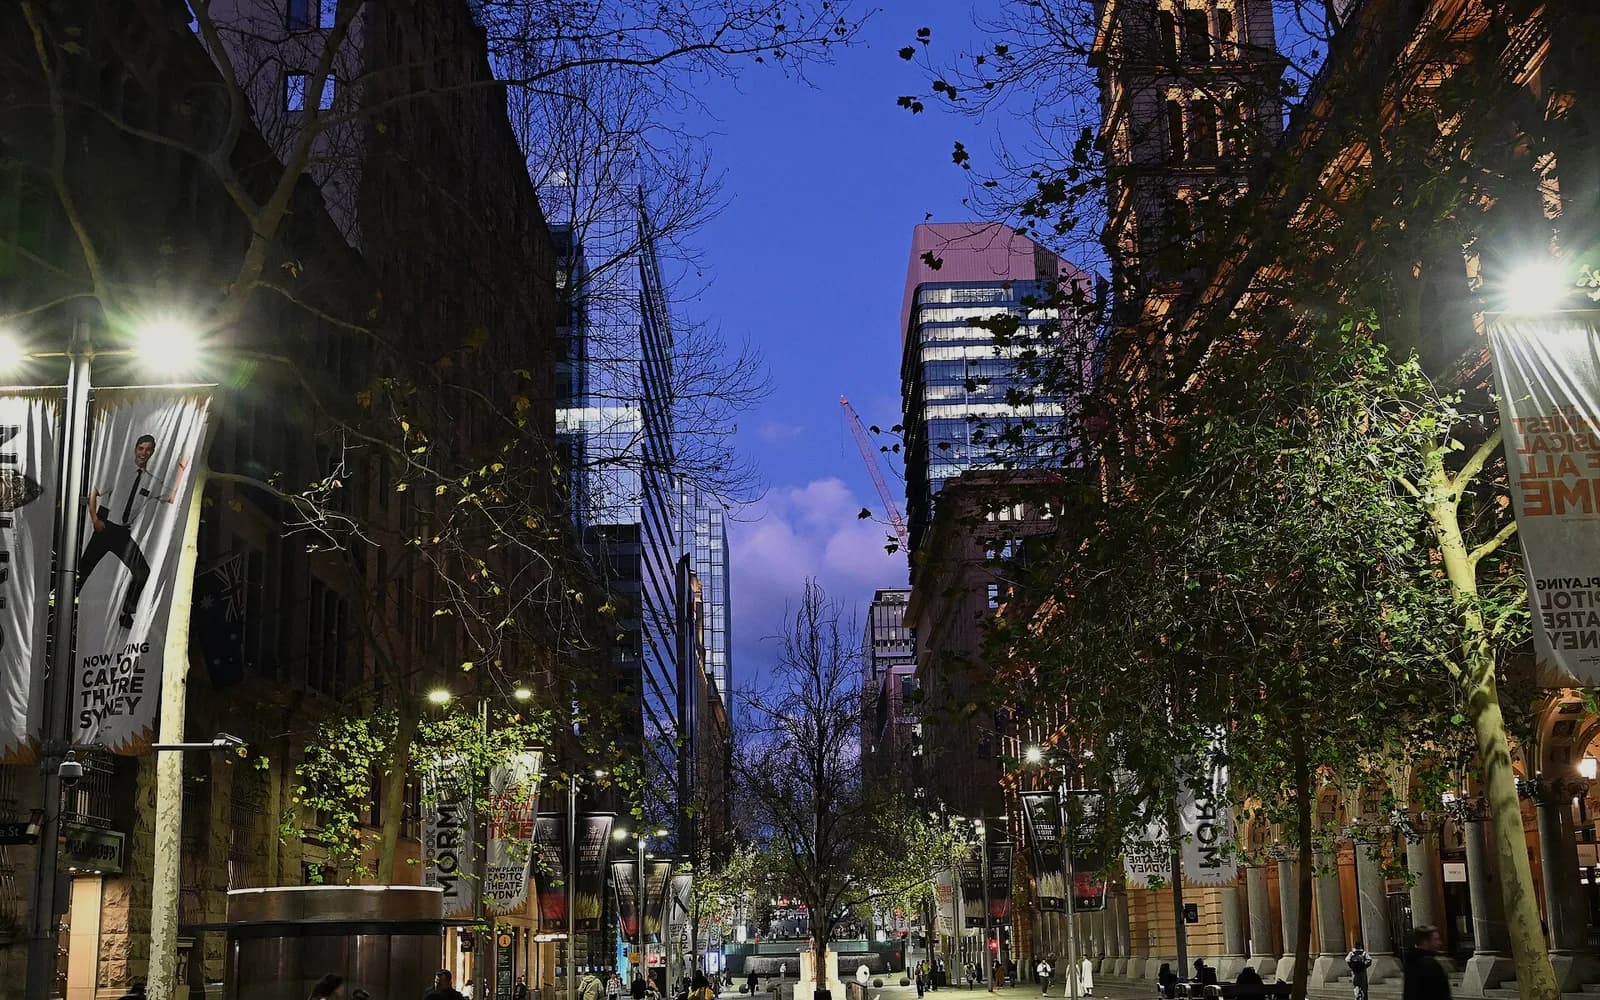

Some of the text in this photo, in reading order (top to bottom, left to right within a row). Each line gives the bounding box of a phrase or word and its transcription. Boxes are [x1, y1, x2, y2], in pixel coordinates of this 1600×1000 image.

[83, 654, 113, 668] NOW
[80, 696, 142, 729] SYNEY
[488, 823, 533, 839] TIE
[487, 872, 523, 881] CAPITO
[487, 889, 521, 900] SYDNY
